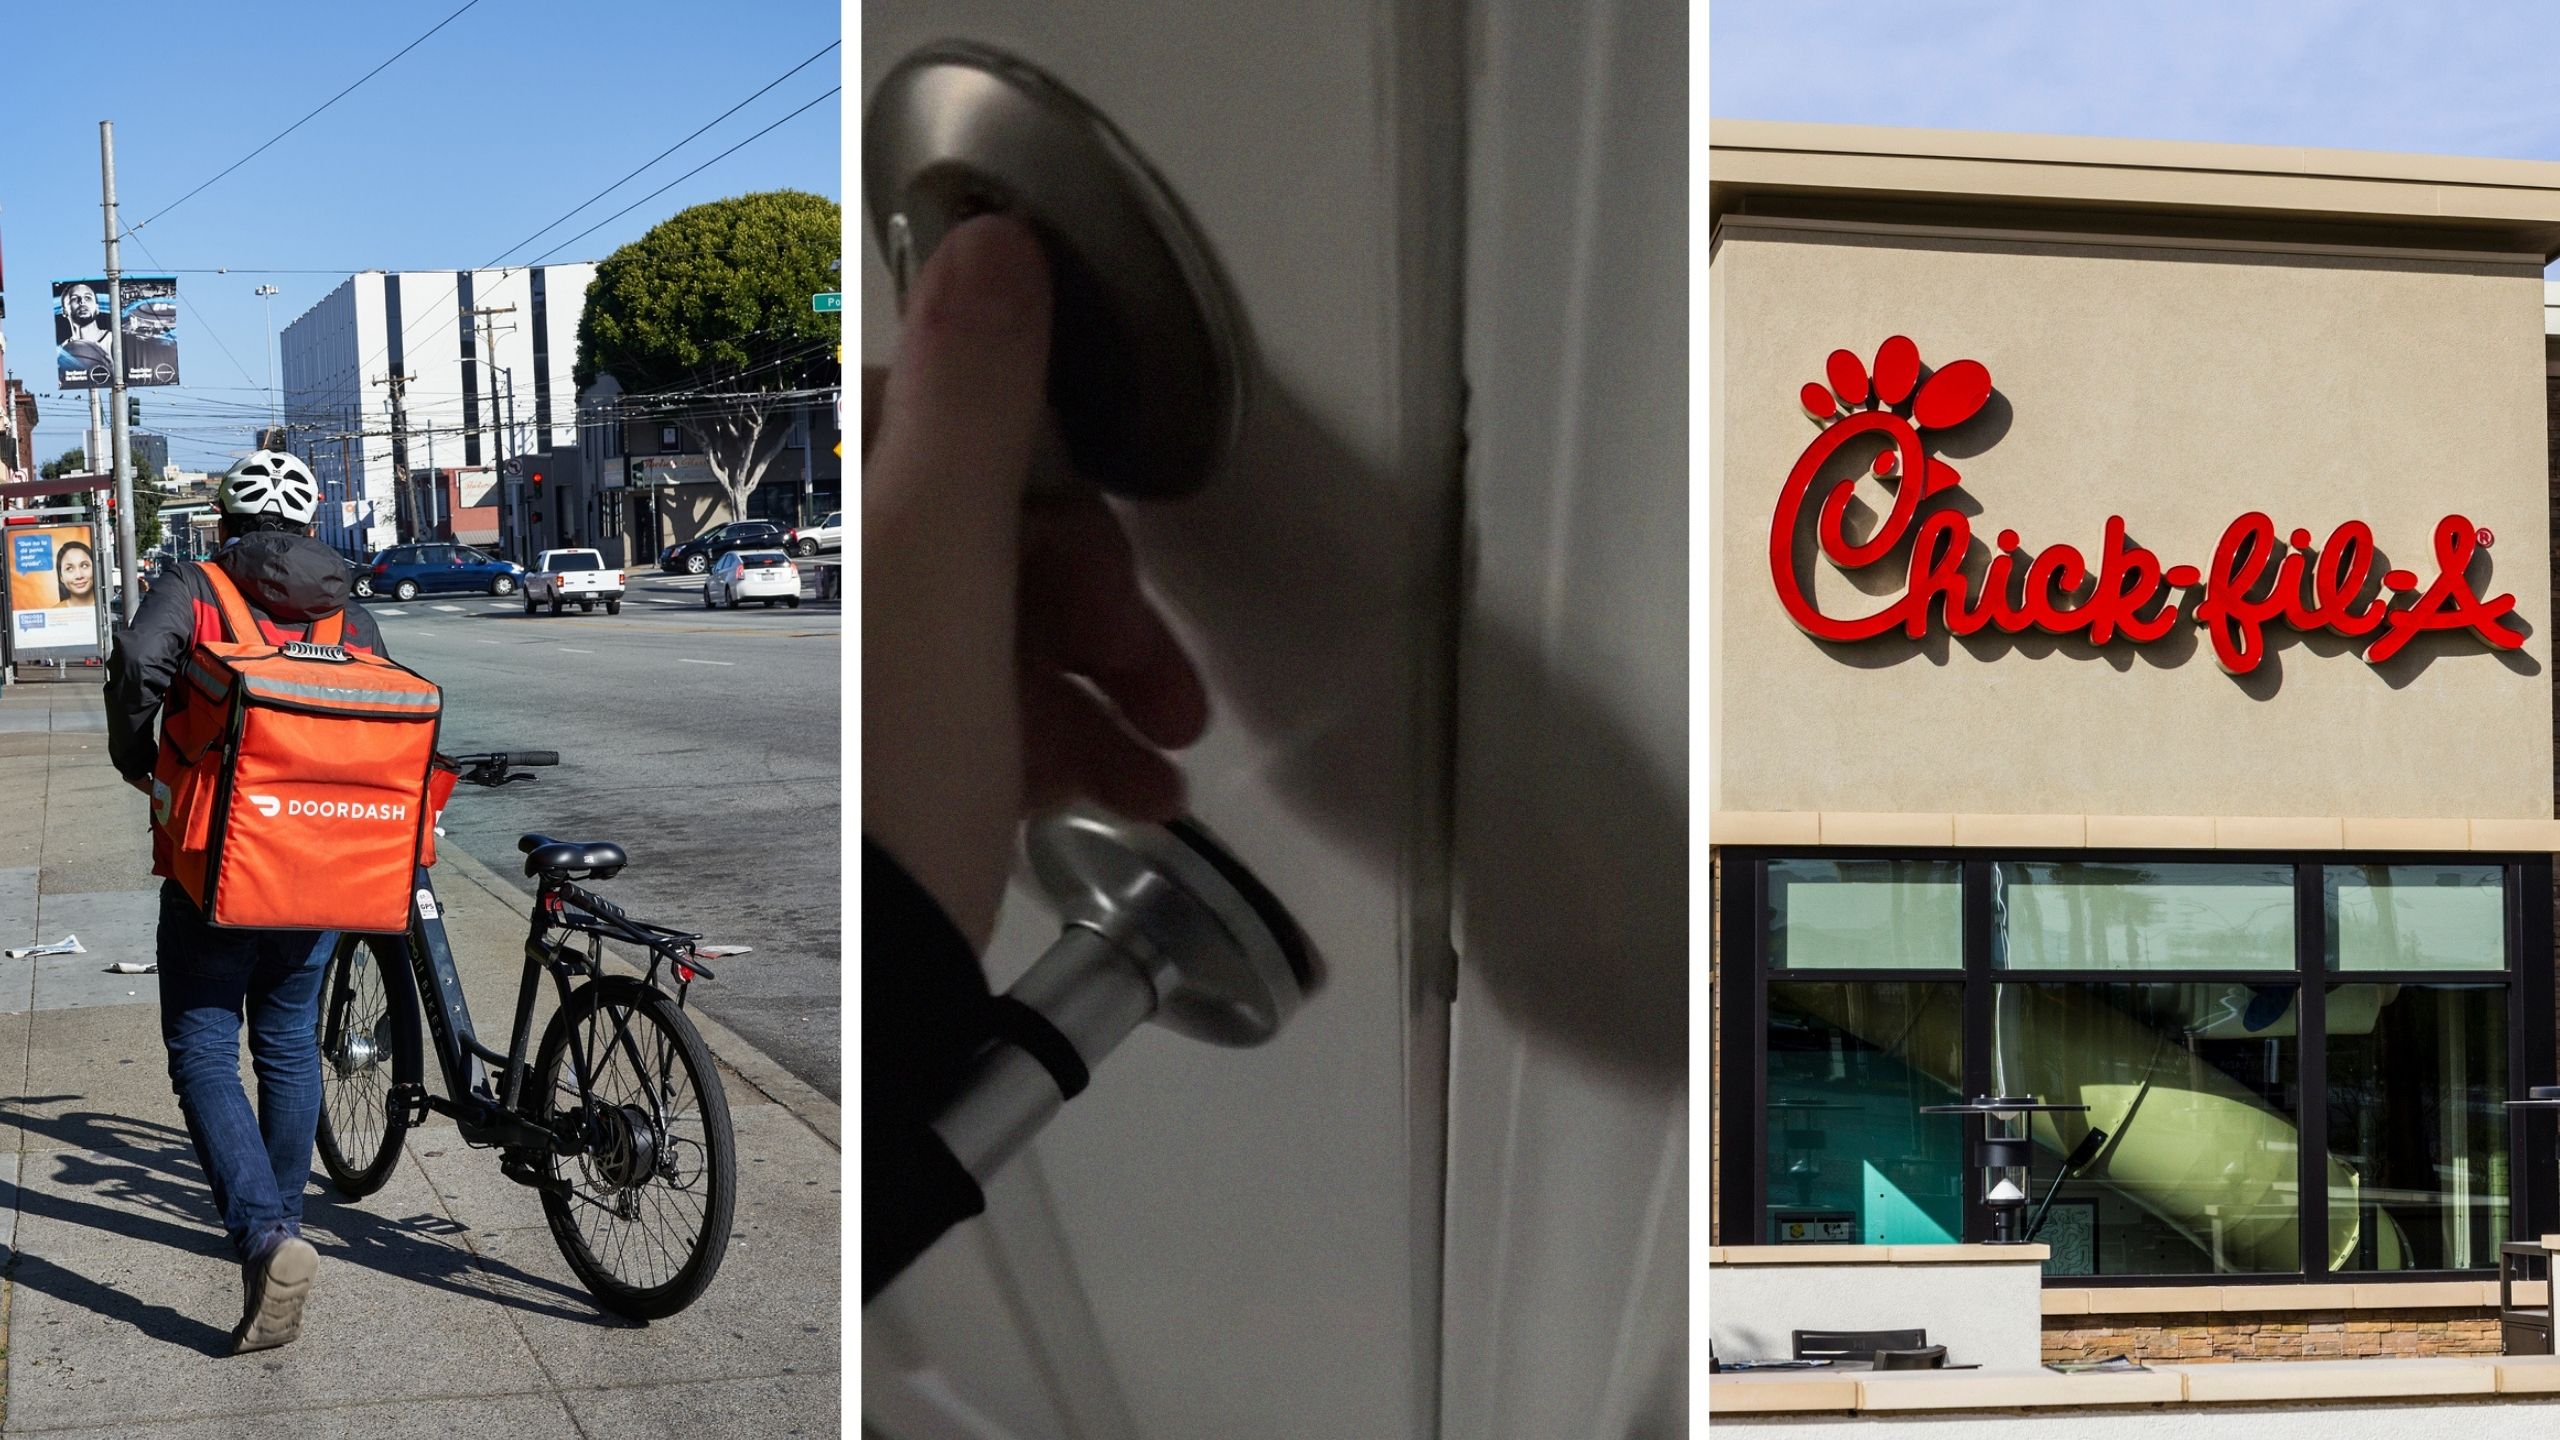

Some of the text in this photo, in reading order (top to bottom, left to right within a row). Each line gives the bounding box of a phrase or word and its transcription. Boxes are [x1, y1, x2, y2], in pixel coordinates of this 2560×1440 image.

[1769, 410, 2524, 675] Chick-fil-A
[288, 799, 405, 820] DOORDASH
[421, 980, 442, 1037] BIKES
